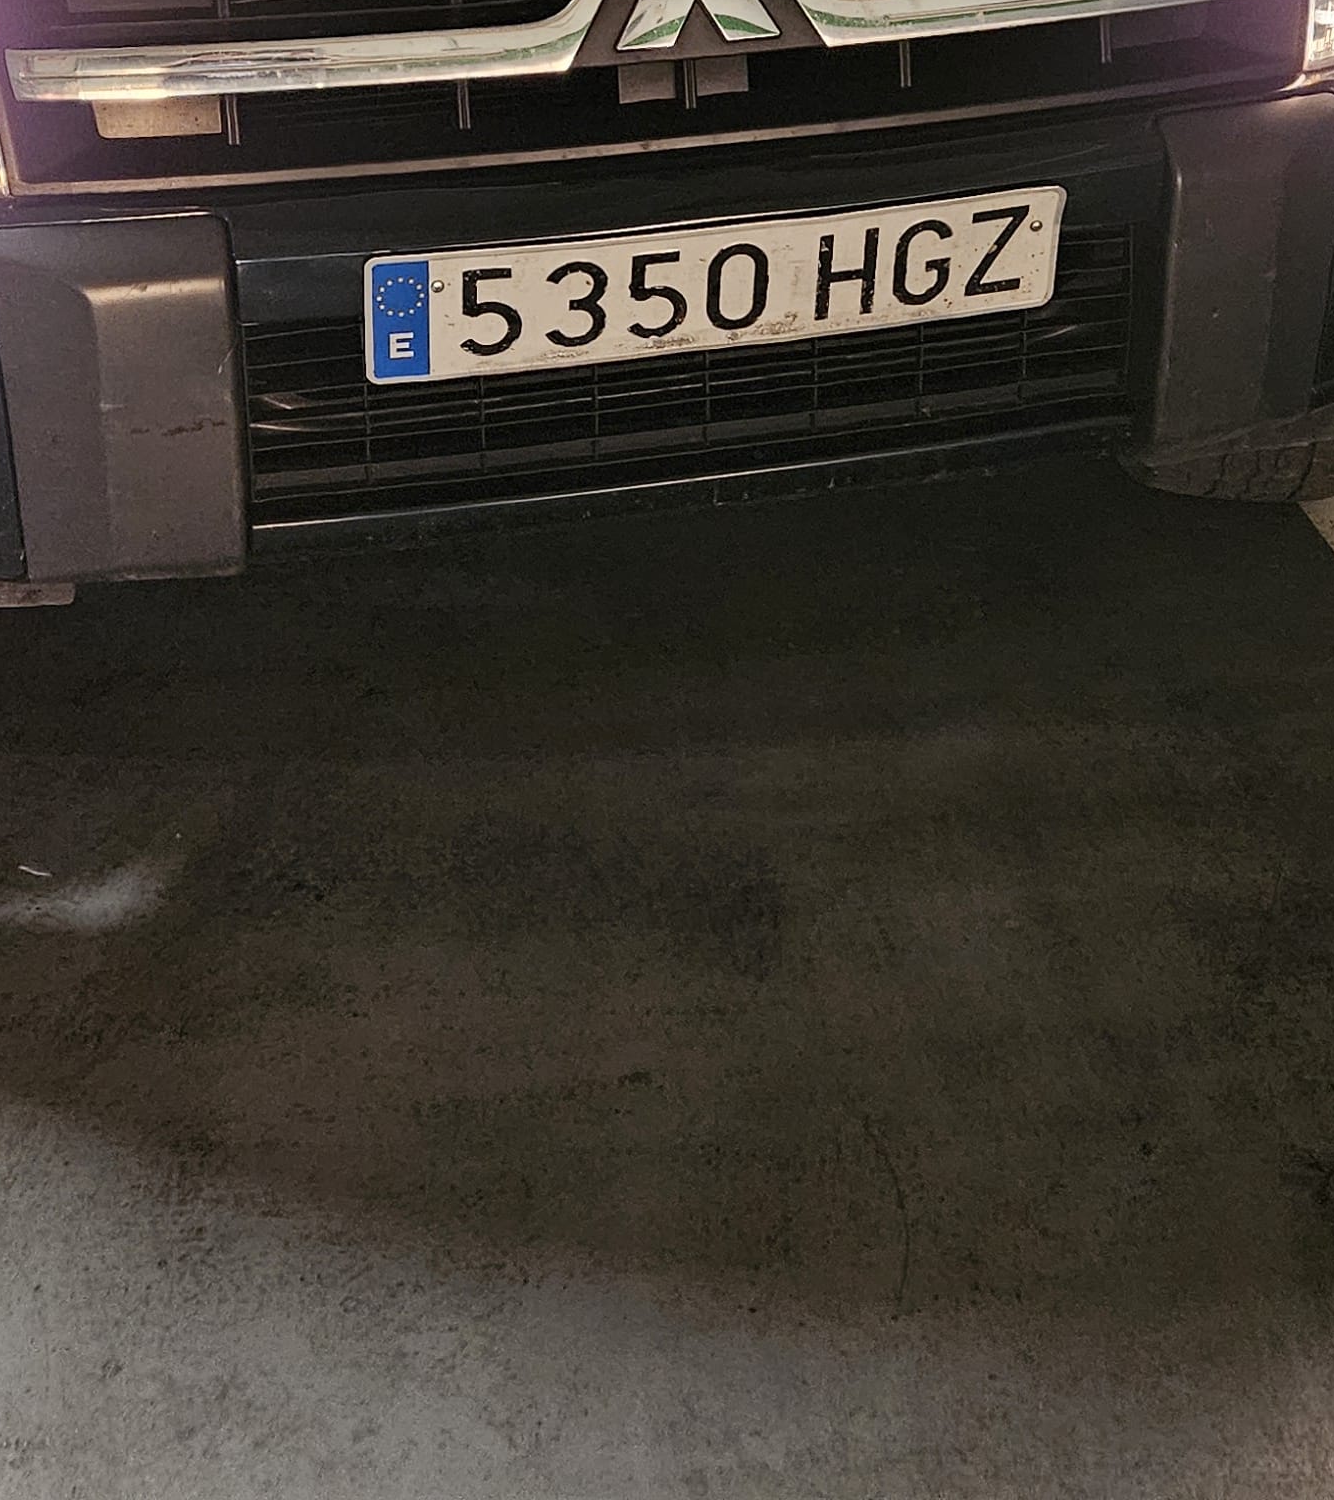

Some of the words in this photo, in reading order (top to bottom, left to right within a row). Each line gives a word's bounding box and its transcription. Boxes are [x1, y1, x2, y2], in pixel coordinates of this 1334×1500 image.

[460, 243, 770, 357] 5350
[814, 204, 1030, 321] HGZ
[389, 331, 414, 359] E
